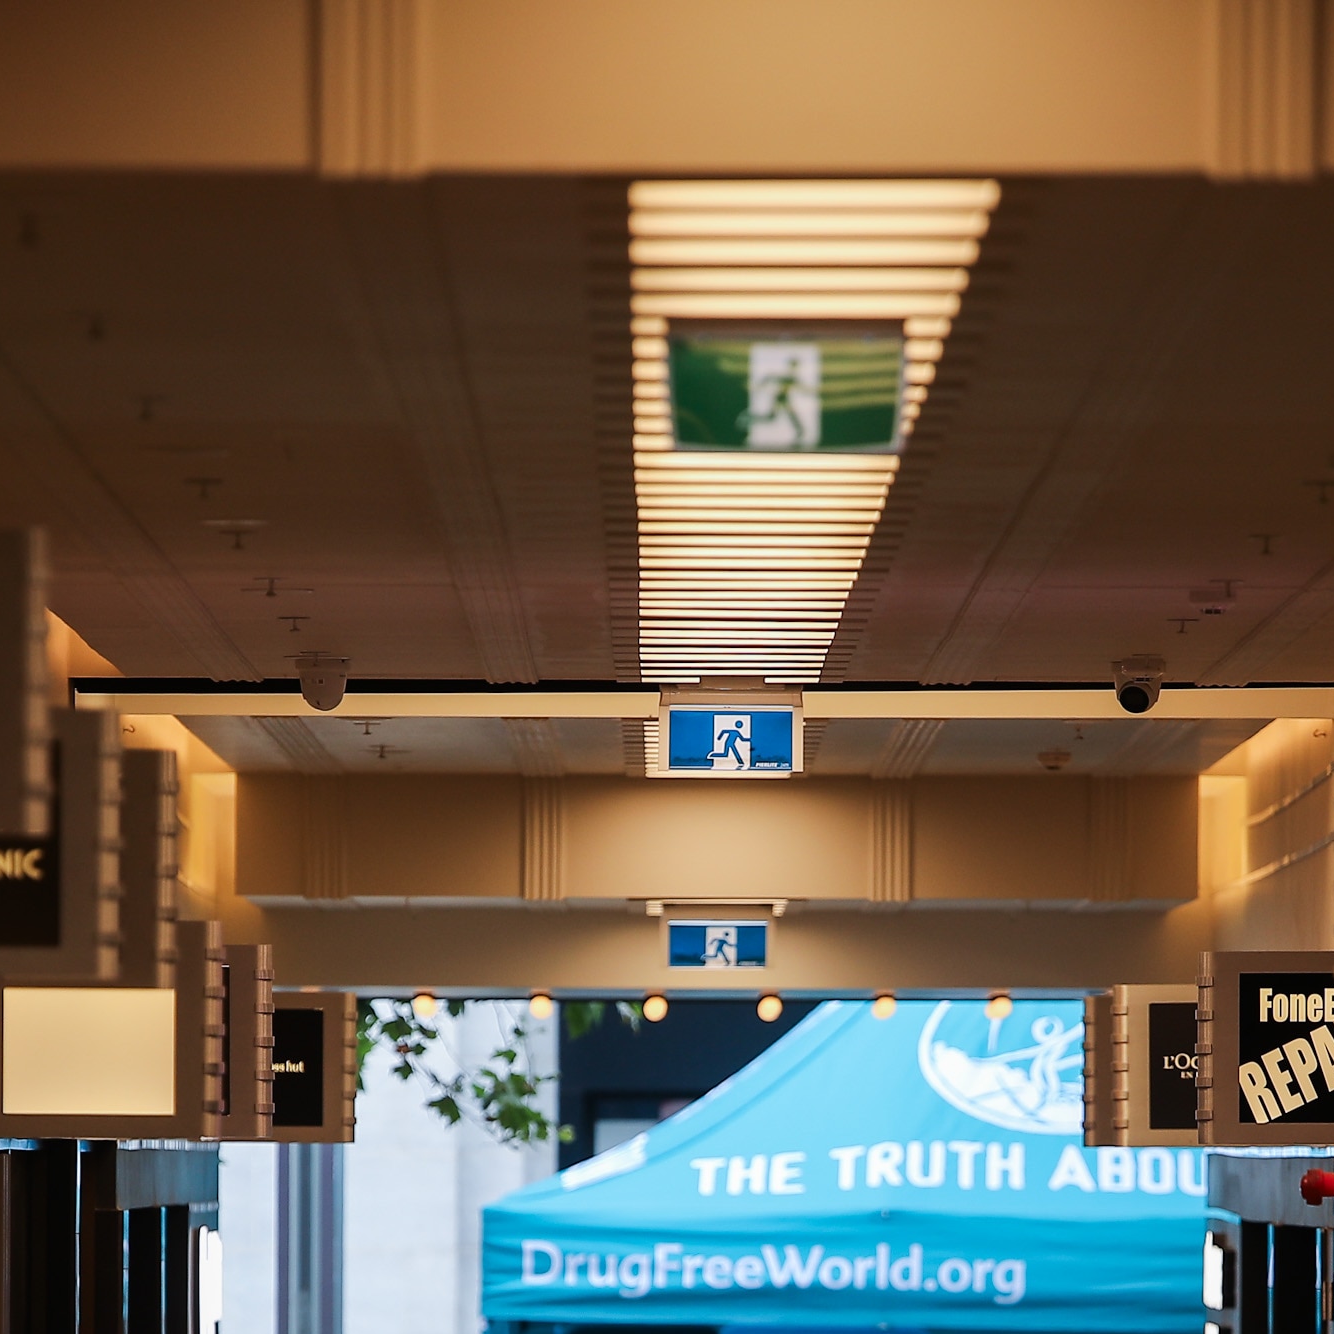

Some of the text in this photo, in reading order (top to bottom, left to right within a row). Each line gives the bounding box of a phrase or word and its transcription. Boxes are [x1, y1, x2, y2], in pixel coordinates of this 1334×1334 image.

[285, 1059, 305, 1073] hut
[689, 1151, 807, 1196] THE
[828, 1139, 1027, 1191] TRUTH
[520, 1240, 1027, 1304] DrugFreeWorld.org
